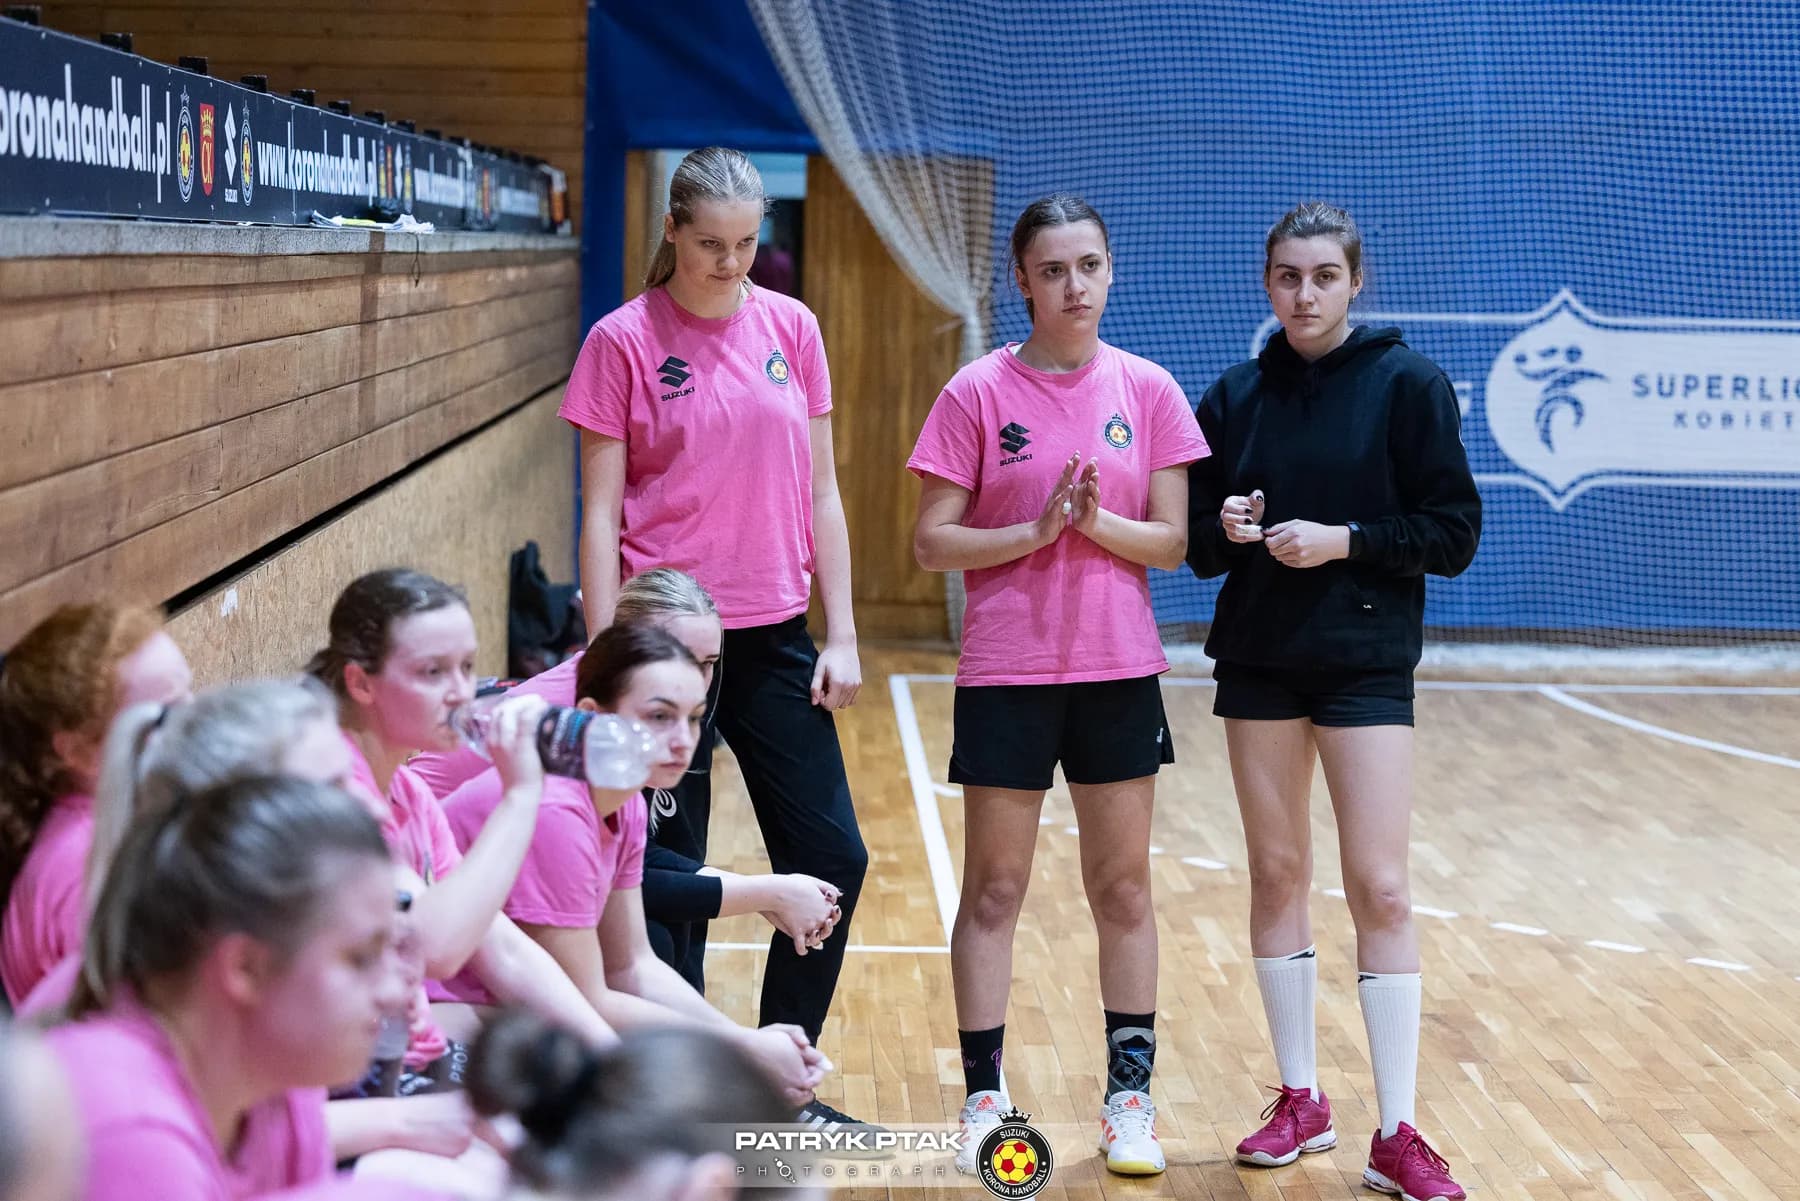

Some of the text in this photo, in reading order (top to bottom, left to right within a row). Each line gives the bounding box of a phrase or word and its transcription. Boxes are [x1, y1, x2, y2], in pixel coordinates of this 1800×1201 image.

[257, 121, 378, 207] www.koronahandball.pl
[661, 386, 696, 402] SUZUKI
[999, 453, 1033, 467] SUZUKI
